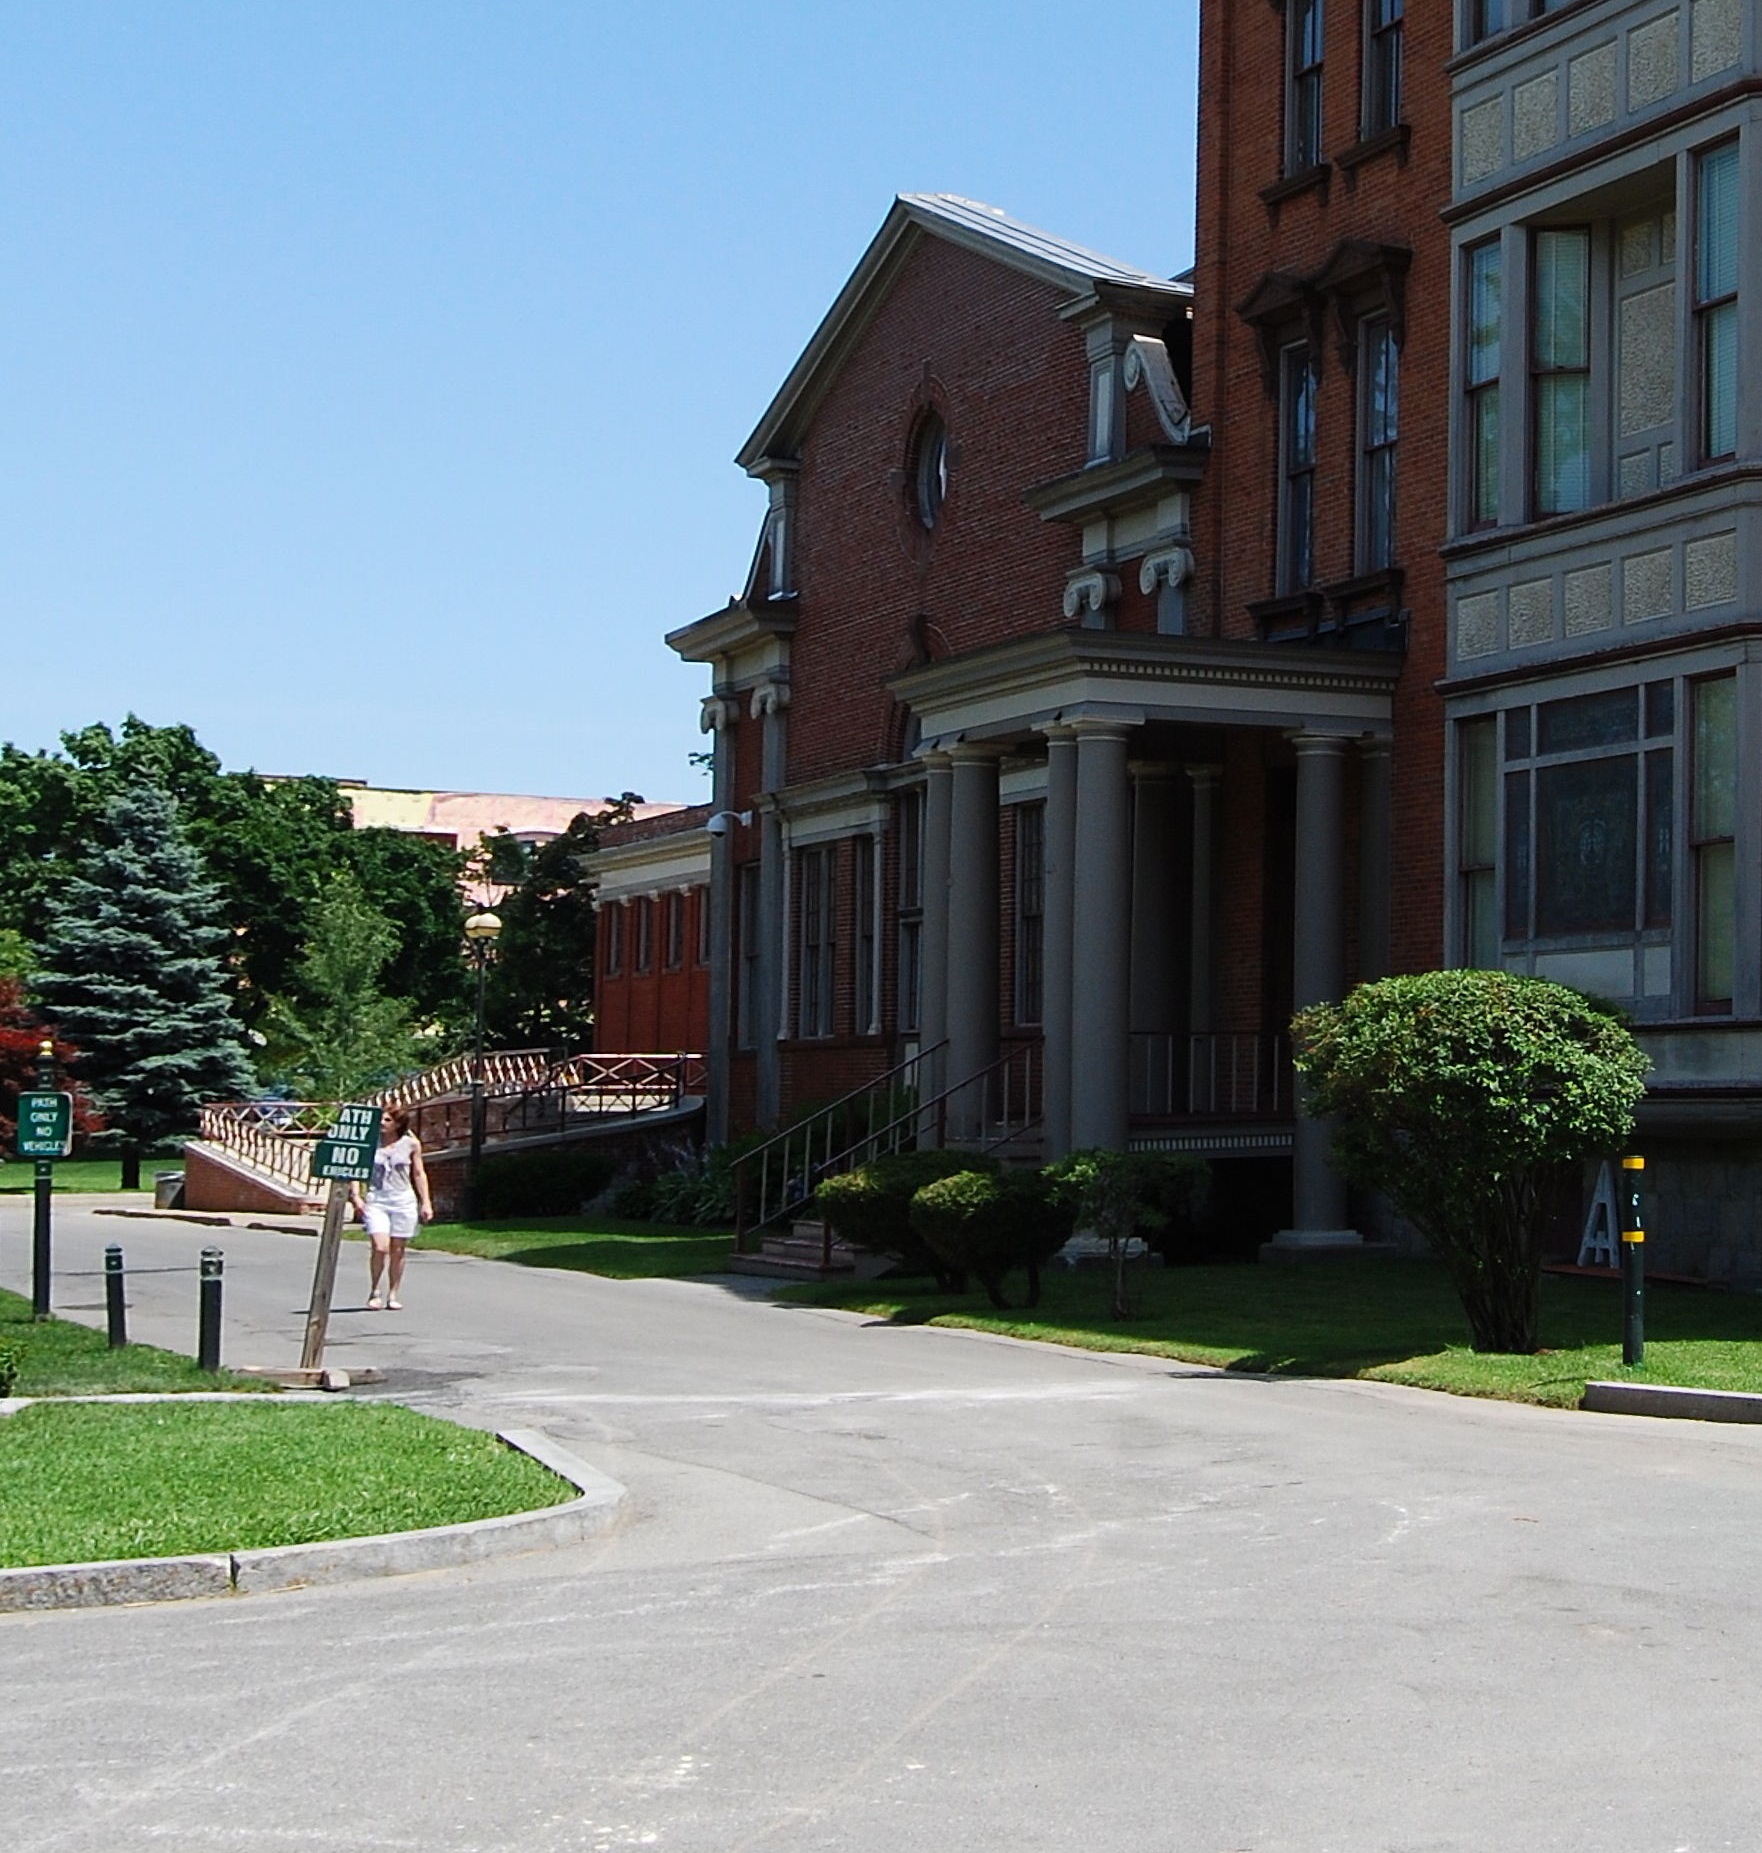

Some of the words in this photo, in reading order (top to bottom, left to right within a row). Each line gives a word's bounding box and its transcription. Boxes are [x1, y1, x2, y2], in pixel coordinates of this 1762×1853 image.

[31, 1097, 58, 1108] PATH
[29, 1112, 59, 1123] ONLY
[35, 1126, 53, 1137] NO
[327, 1123, 370, 1141] ONLY
[331, 1146, 360, 1166] NO
